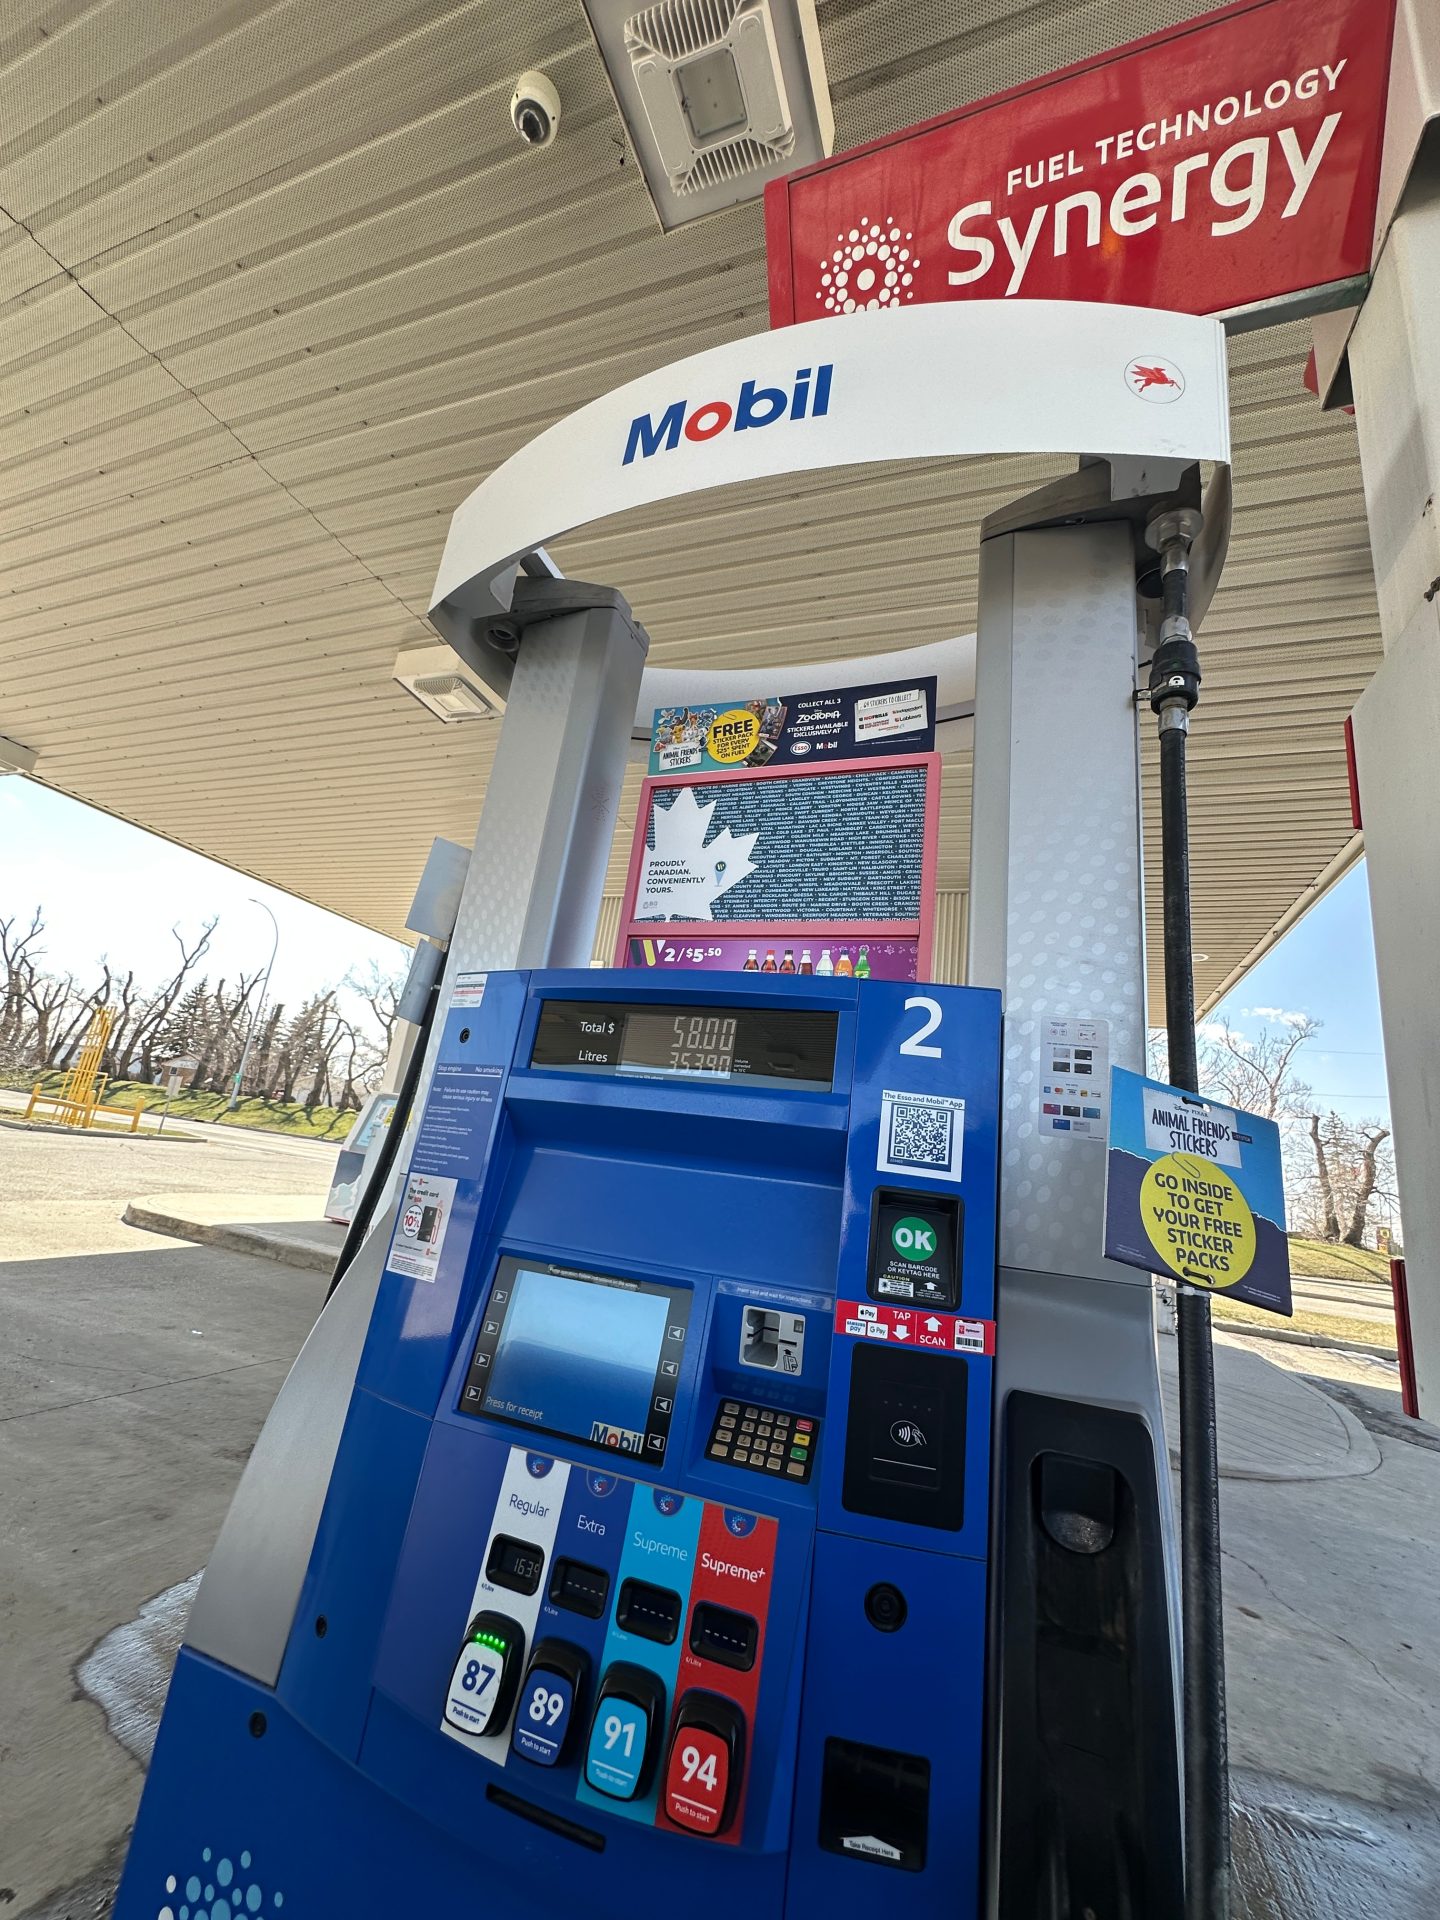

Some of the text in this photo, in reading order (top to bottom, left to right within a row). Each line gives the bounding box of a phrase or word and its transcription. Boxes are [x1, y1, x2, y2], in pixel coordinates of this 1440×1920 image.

[1007, 58, 1348, 196] FUEL TECHNOLOGY
[947, 111, 1343, 297] Synergy
[622, 364, 833, 466] Mobil
[798, 701, 823, 709] COLLECT
[870, 698, 888, 707] STICKERS
[895, 693, 912, 702] COLLECT
[713, 719, 753, 738] FREE
[787, 725, 814, 733] STICKERS
[794, 730, 828, 738] EXCLUSIVELY
[713, 736, 736, 744] STICKER
[730, 738, 750, 747] EVERY
[731, 743, 750, 751] SPENT
[816, 741, 837, 750] Mobil
[663, 750, 679, 760] ANIMAL
[669, 756, 691, 767] STICKERS
[648, 868, 691, 876] CANADIAN.
[580, 1022, 615, 1034] Total $
[671, 1016, 737, 1051] 58.00
[899, 996, 943, 1059] 2
[578, 1050, 608, 1062] Litres
[669, 1052, 731, 1076] 35.390
[949, 1100, 963, 1108] App
[1173, 1103, 1208, 1118] Disney PIXAR
[1152, 1108, 1190, 1132] ANIMAL
[1192, 1117, 1231, 1141] FRIENDS
[1169, 1131, 1218, 1158] STICKERS
[1154, 1173, 1233, 1201] GO INSIDE
[1167, 1192, 1223, 1217] TO GET
[1153, 1207, 1243, 1238] YOUR FREE
[895, 1227, 933, 1251] OK
[1167, 1228, 1234, 1255] STICKER
[908, 1264, 937, 1273] BARCODE
[1176, 1248, 1230, 1272] PACKS
[898, 1268, 922, 1277] KEYTAG
[865, 1308, 875, 1318] Pay
[892, 1310, 911, 1321] TAP
[849, 1325, 861, 1333] pay
[876, 1327, 886, 1335] Pay
[919, 1335, 946, 1346] SCAN
[486, 1396, 544, 1420] Press for receipt
[591, 1423, 643, 1453] Mobil
[510, 1493, 550, 1517] Regular
[577, 1515, 606, 1535] Extra
[633, 1532, 688, 1561] Supreme
[701, 1553, 766, 1583] Supreme+
[462, 1659, 496, 1695] 87
[452, 1706, 463, 1717] Push
[469, 1714, 480, 1724] start
[529, 1687, 564, 1726] 89
[604, 1715, 636, 1758] 91
[521, 1737, 551, 1756] Push to start
[682, 1745, 718, 1791] 94
[676, 1802, 710, 1822] Push to start
[849, 1840, 860, 1848] Take
[862, 1843, 880, 1853] Receipt
